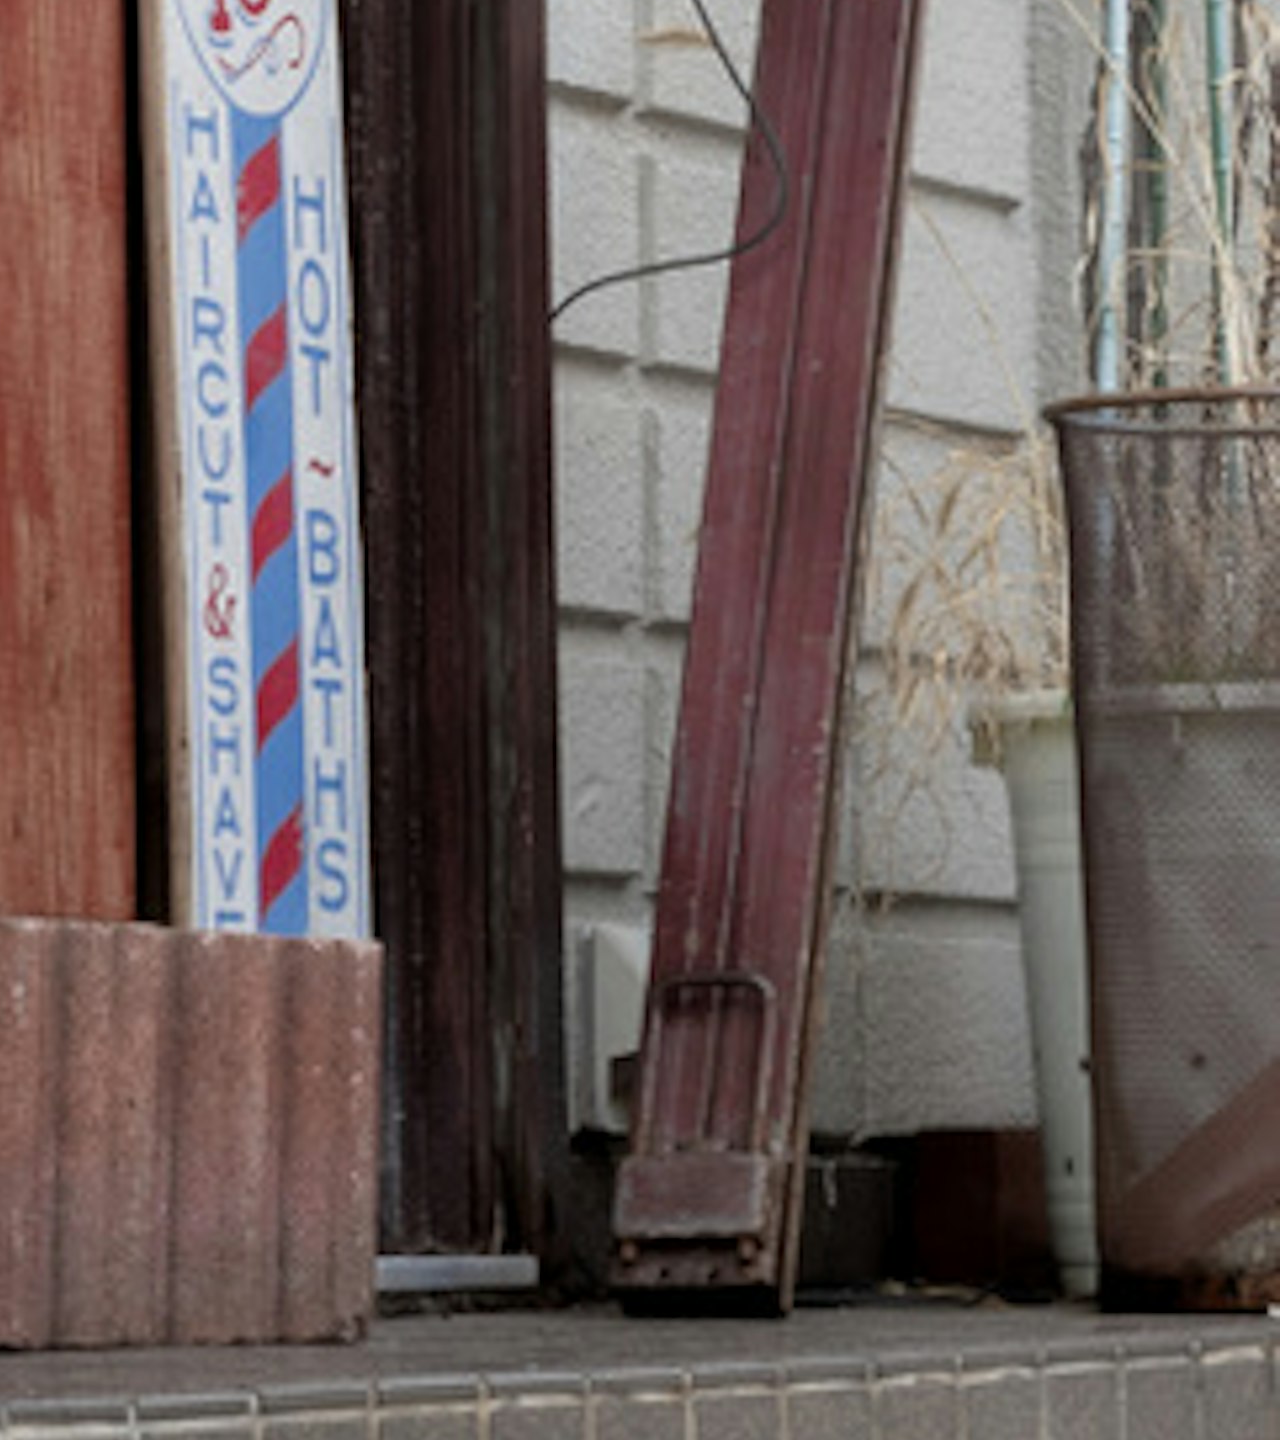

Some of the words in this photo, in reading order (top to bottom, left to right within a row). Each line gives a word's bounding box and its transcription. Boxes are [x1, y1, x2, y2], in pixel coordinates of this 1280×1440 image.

[184, 98, 232, 549] HAIRCUT
[291, 170, 332, 419] HOT
[204, 562, 237, 642] &
[304, 507, 360, 913] BATHS
[207, 656, 246, 931] SHAV
